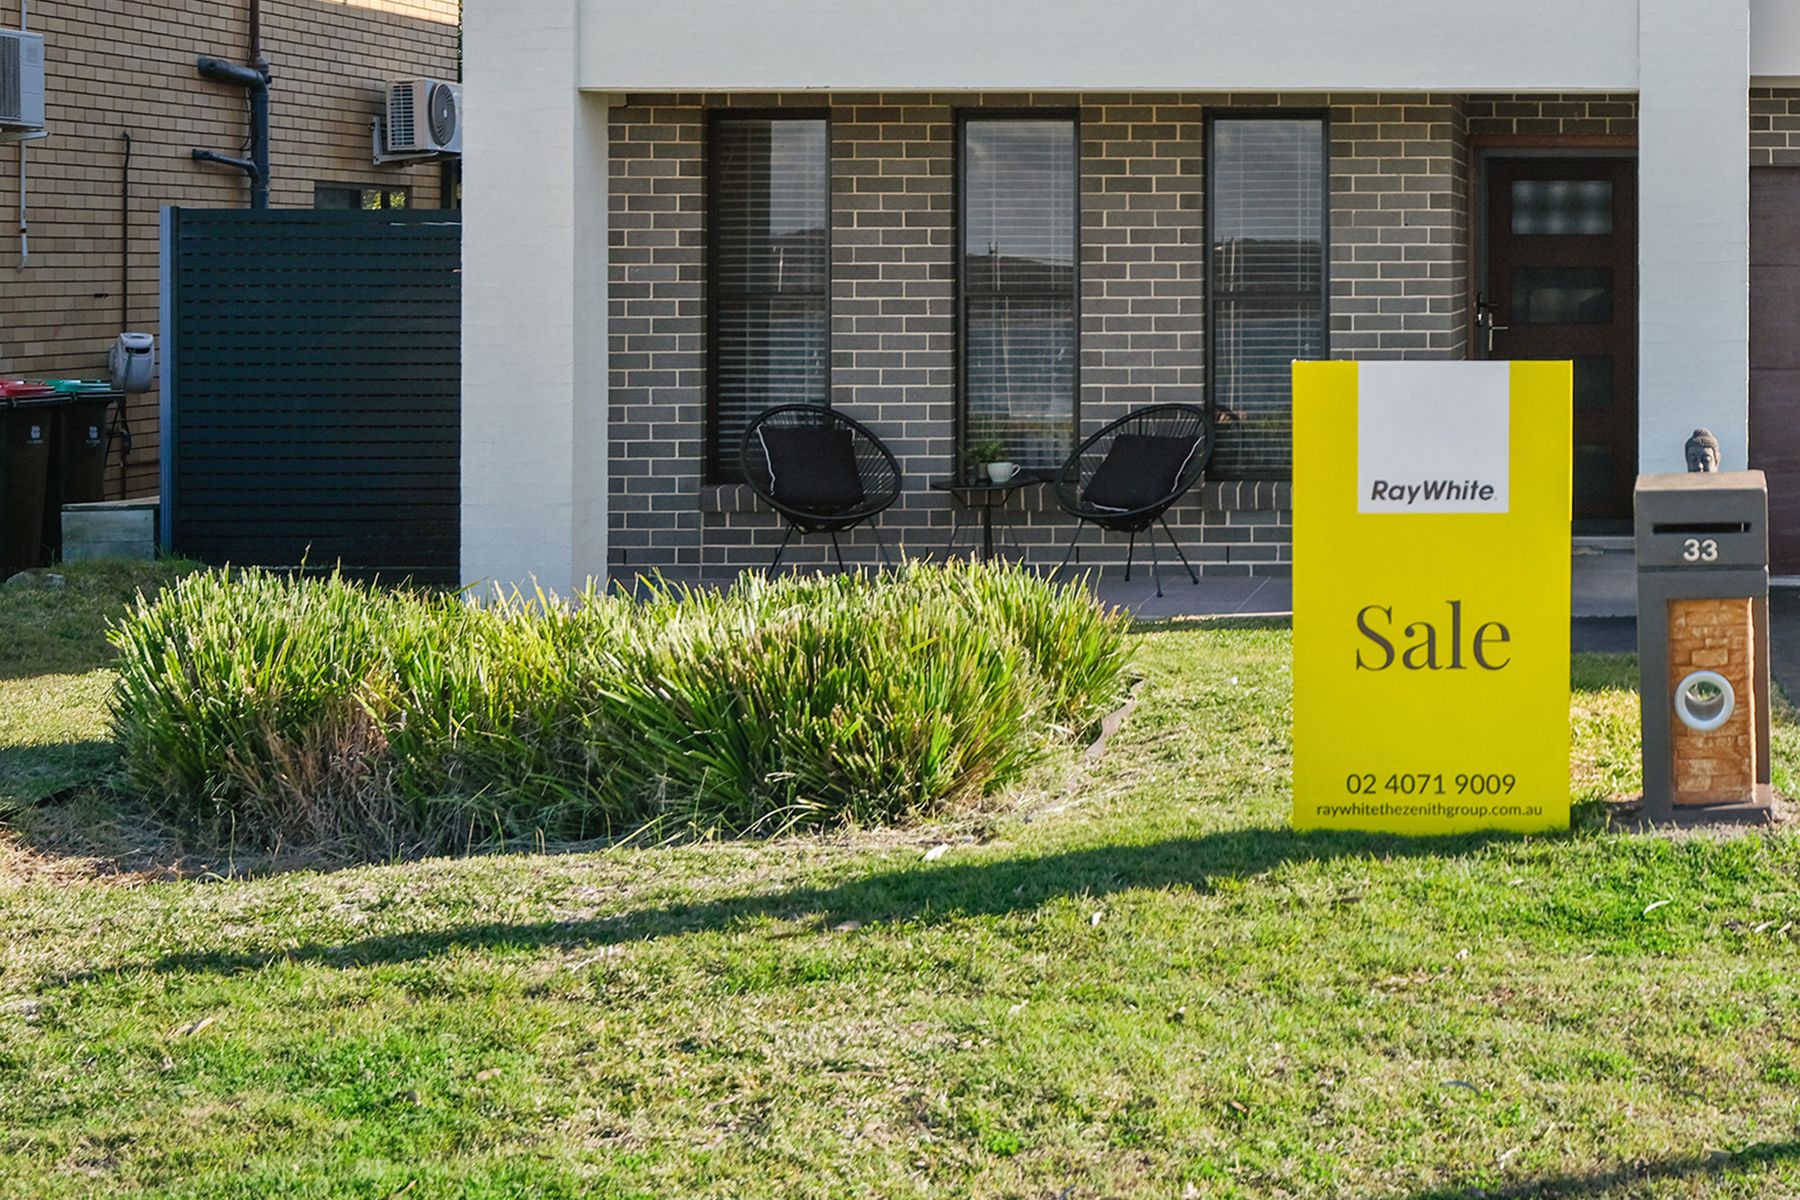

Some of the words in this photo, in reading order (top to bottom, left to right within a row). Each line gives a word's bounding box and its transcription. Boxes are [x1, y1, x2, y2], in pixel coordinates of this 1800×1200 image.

[1683, 538, 1719, 562] 33
[1355, 600, 1511, 672] Sale
[1346, 773, 1377, 795] 02
[1384, 773, 1446, 795] 4071
[1454, 773, 1516, 795] 9009
[1316, 802, 1543, 818] raywhitethezenithgroup.com.au
